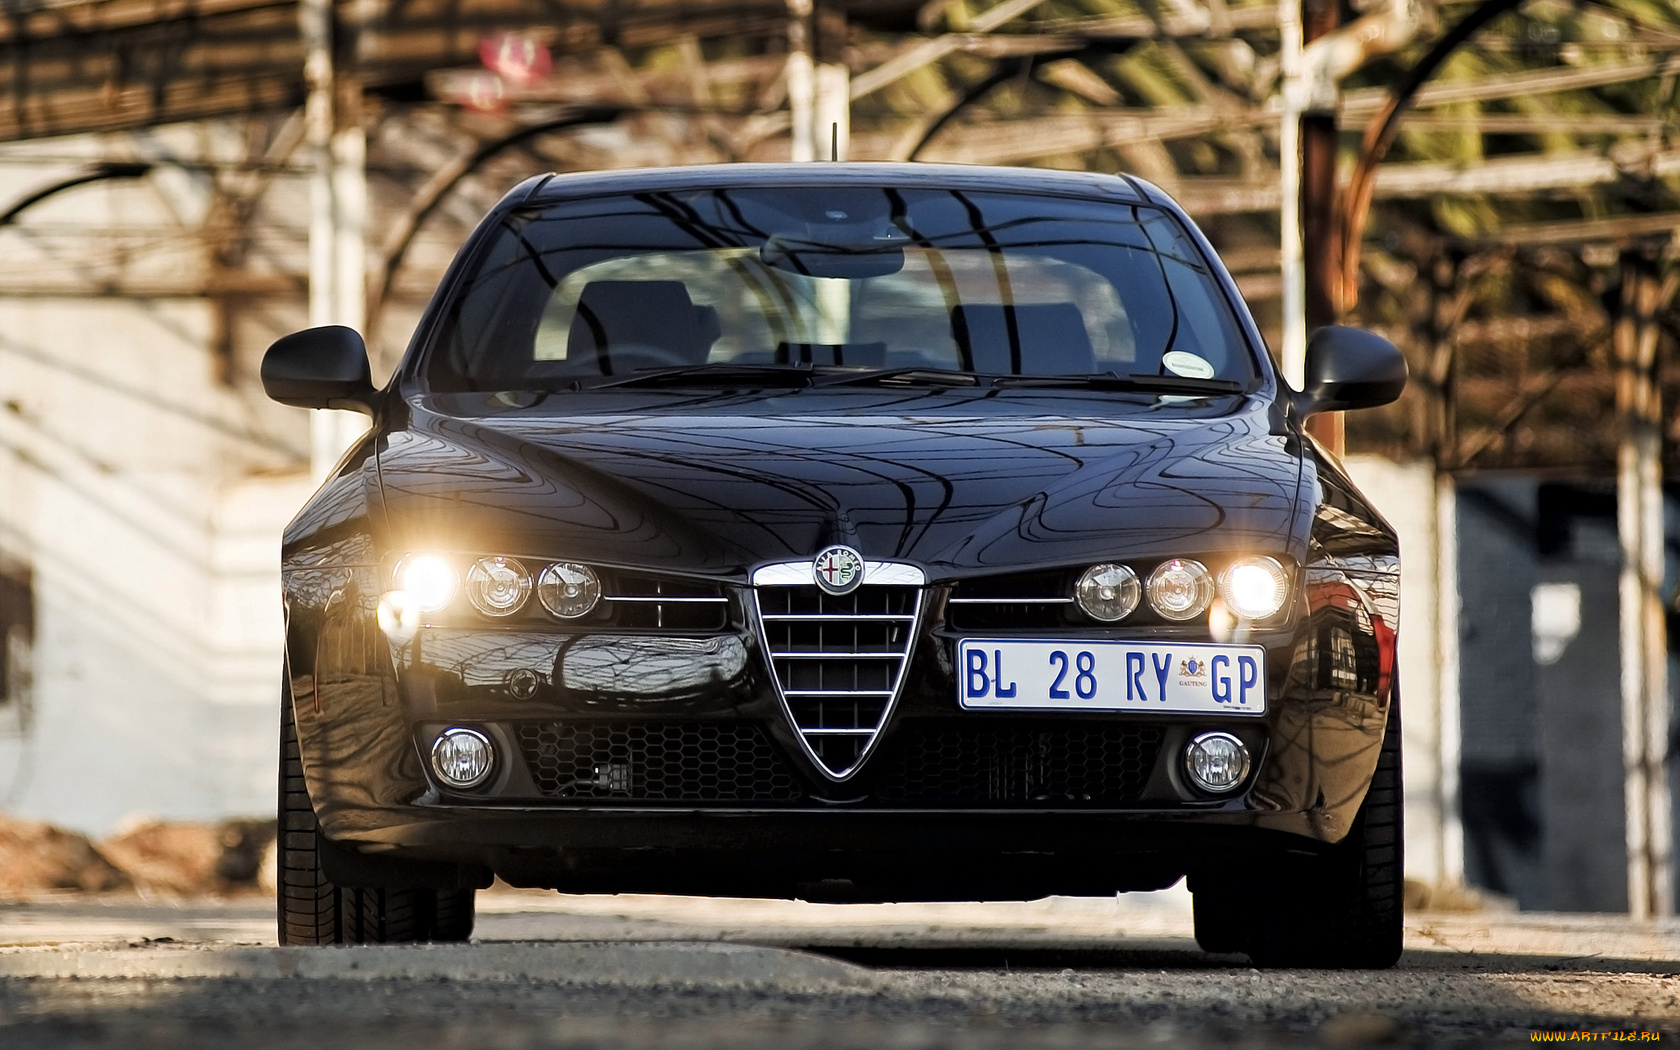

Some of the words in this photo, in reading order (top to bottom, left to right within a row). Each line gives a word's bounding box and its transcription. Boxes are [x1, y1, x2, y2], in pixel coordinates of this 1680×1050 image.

[966, 648, 1017, 699] BL
[1049, 650, 1097, 700] 28
[1126, 652, 1173, 702] RY
[1211, 655, 1258, 705] GP
[1178, 680, 1208, 688] GAUTENG
